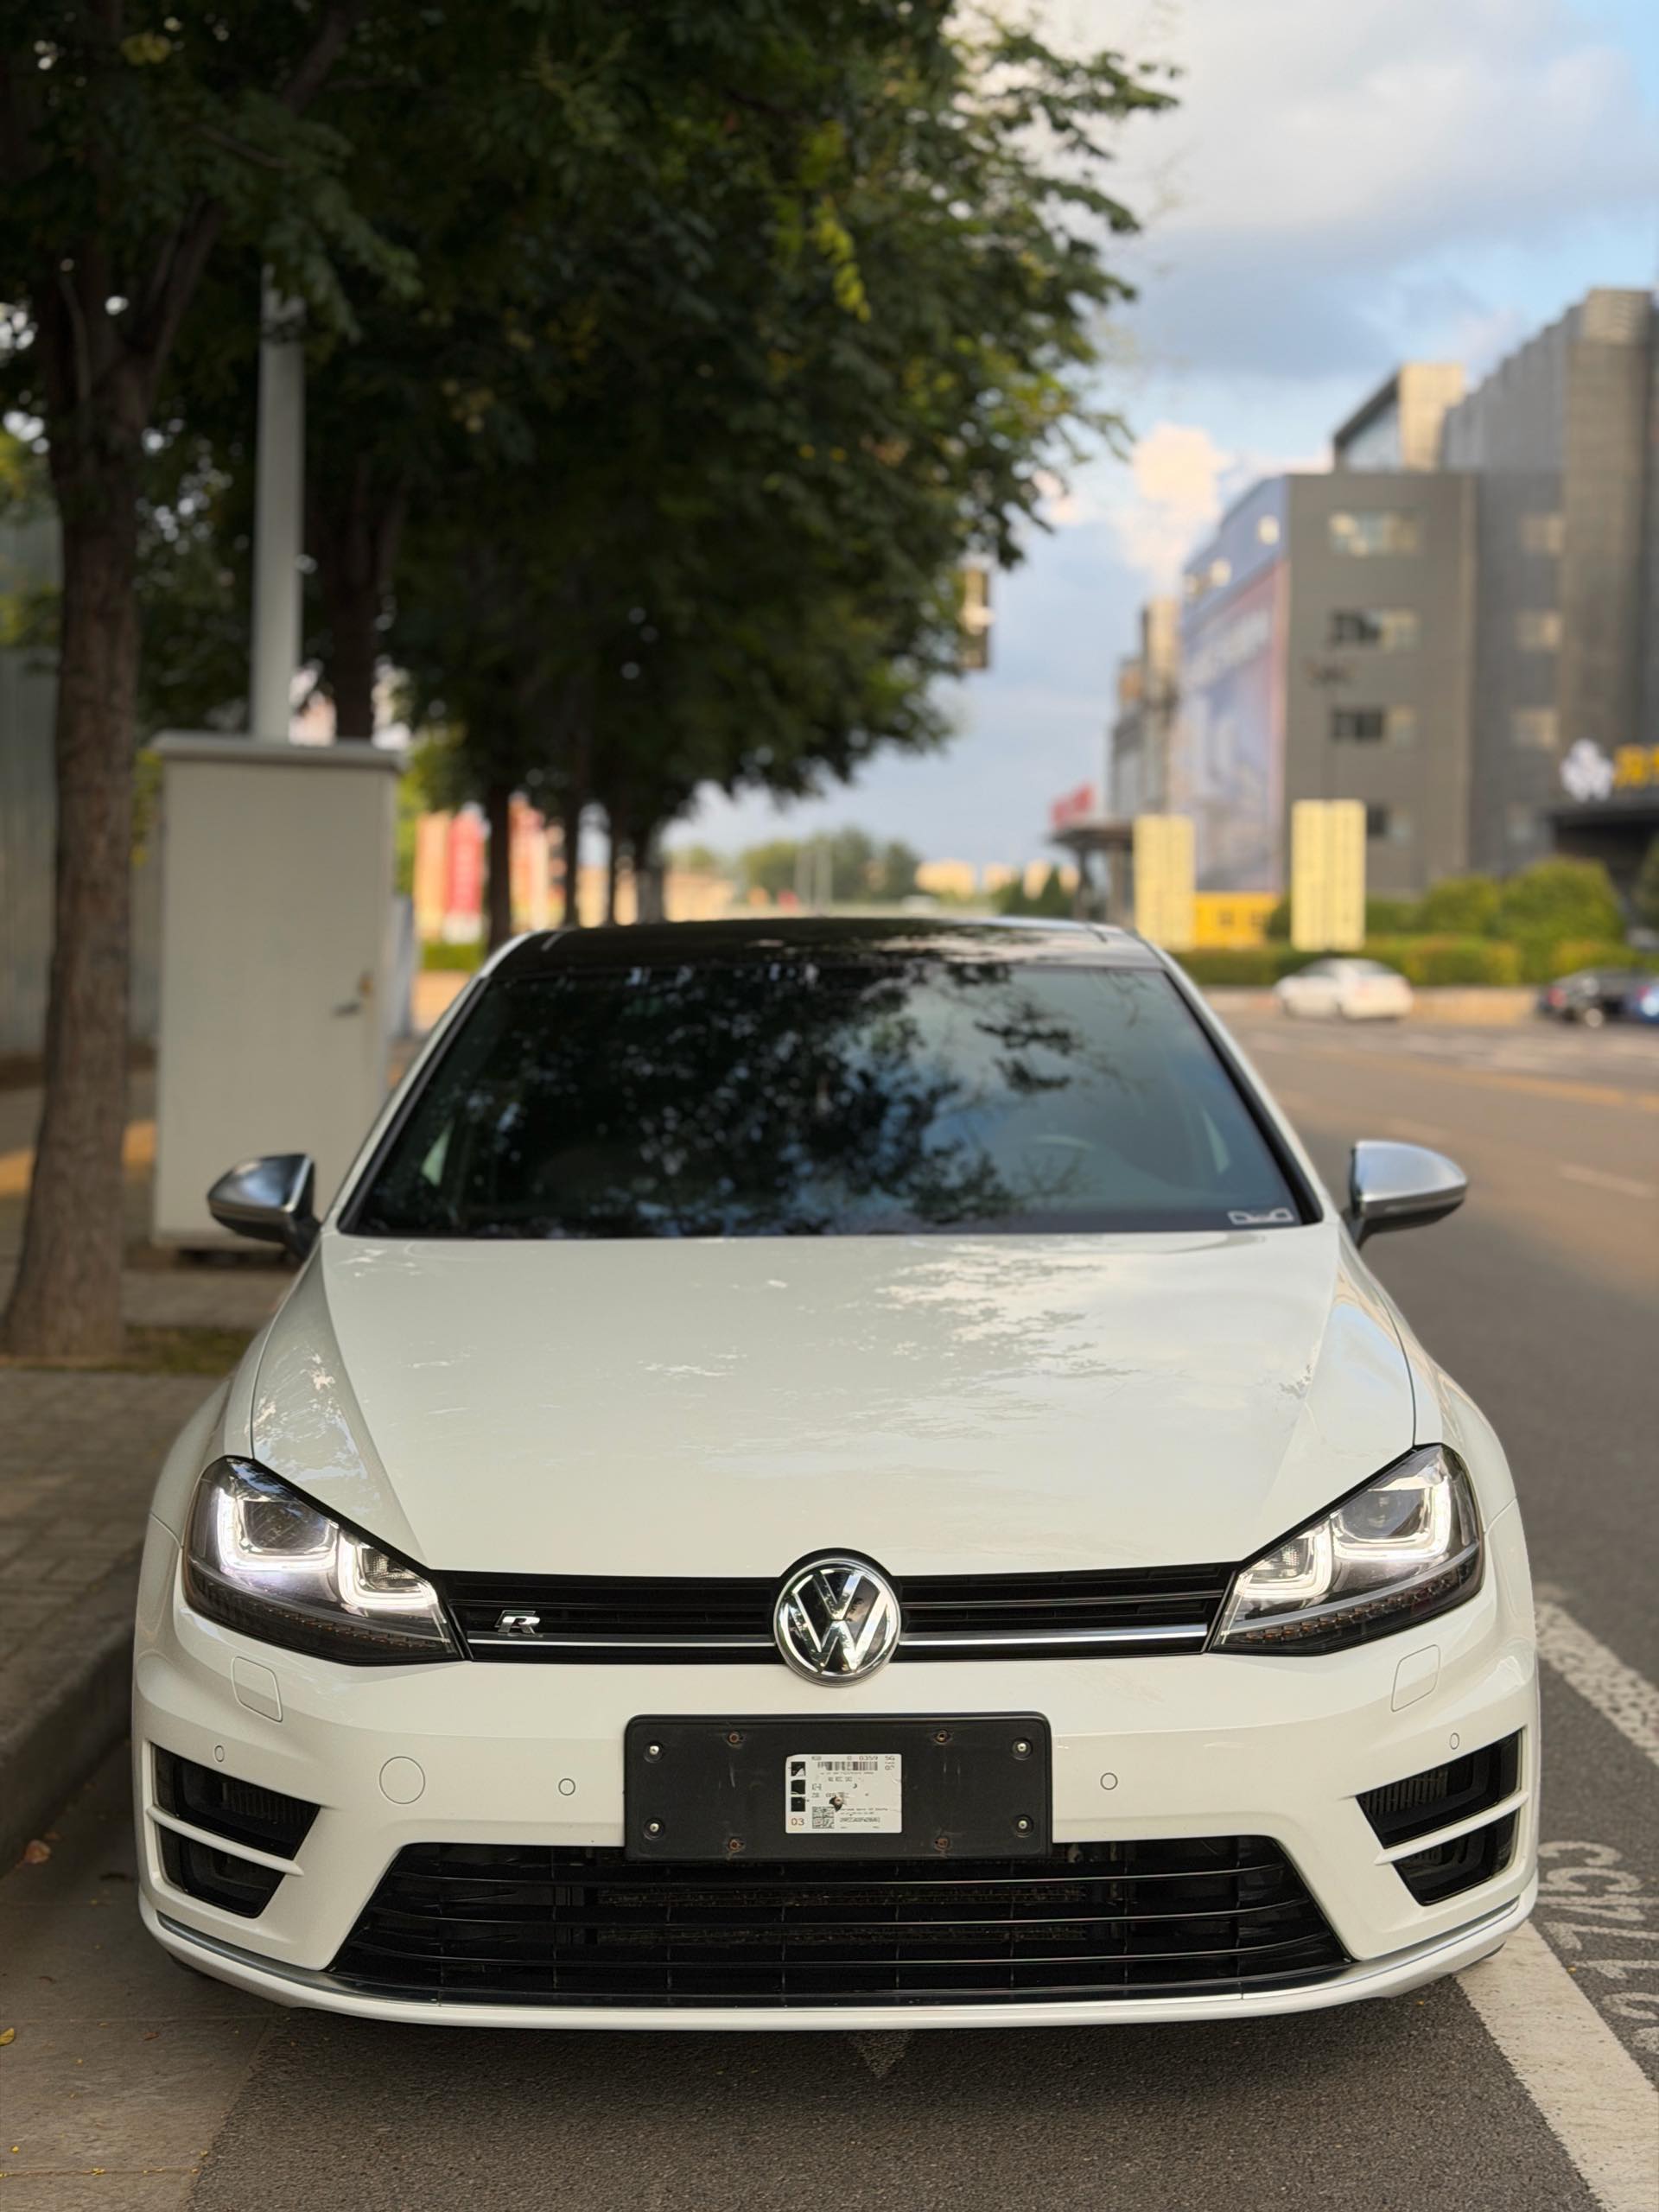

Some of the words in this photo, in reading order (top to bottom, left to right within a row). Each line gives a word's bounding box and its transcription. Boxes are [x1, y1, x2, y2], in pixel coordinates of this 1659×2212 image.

[496, 1613, 542, 1635] R
[781, 1562, 893, 1678] VW
[791, 1817, 805, 1826] 03
